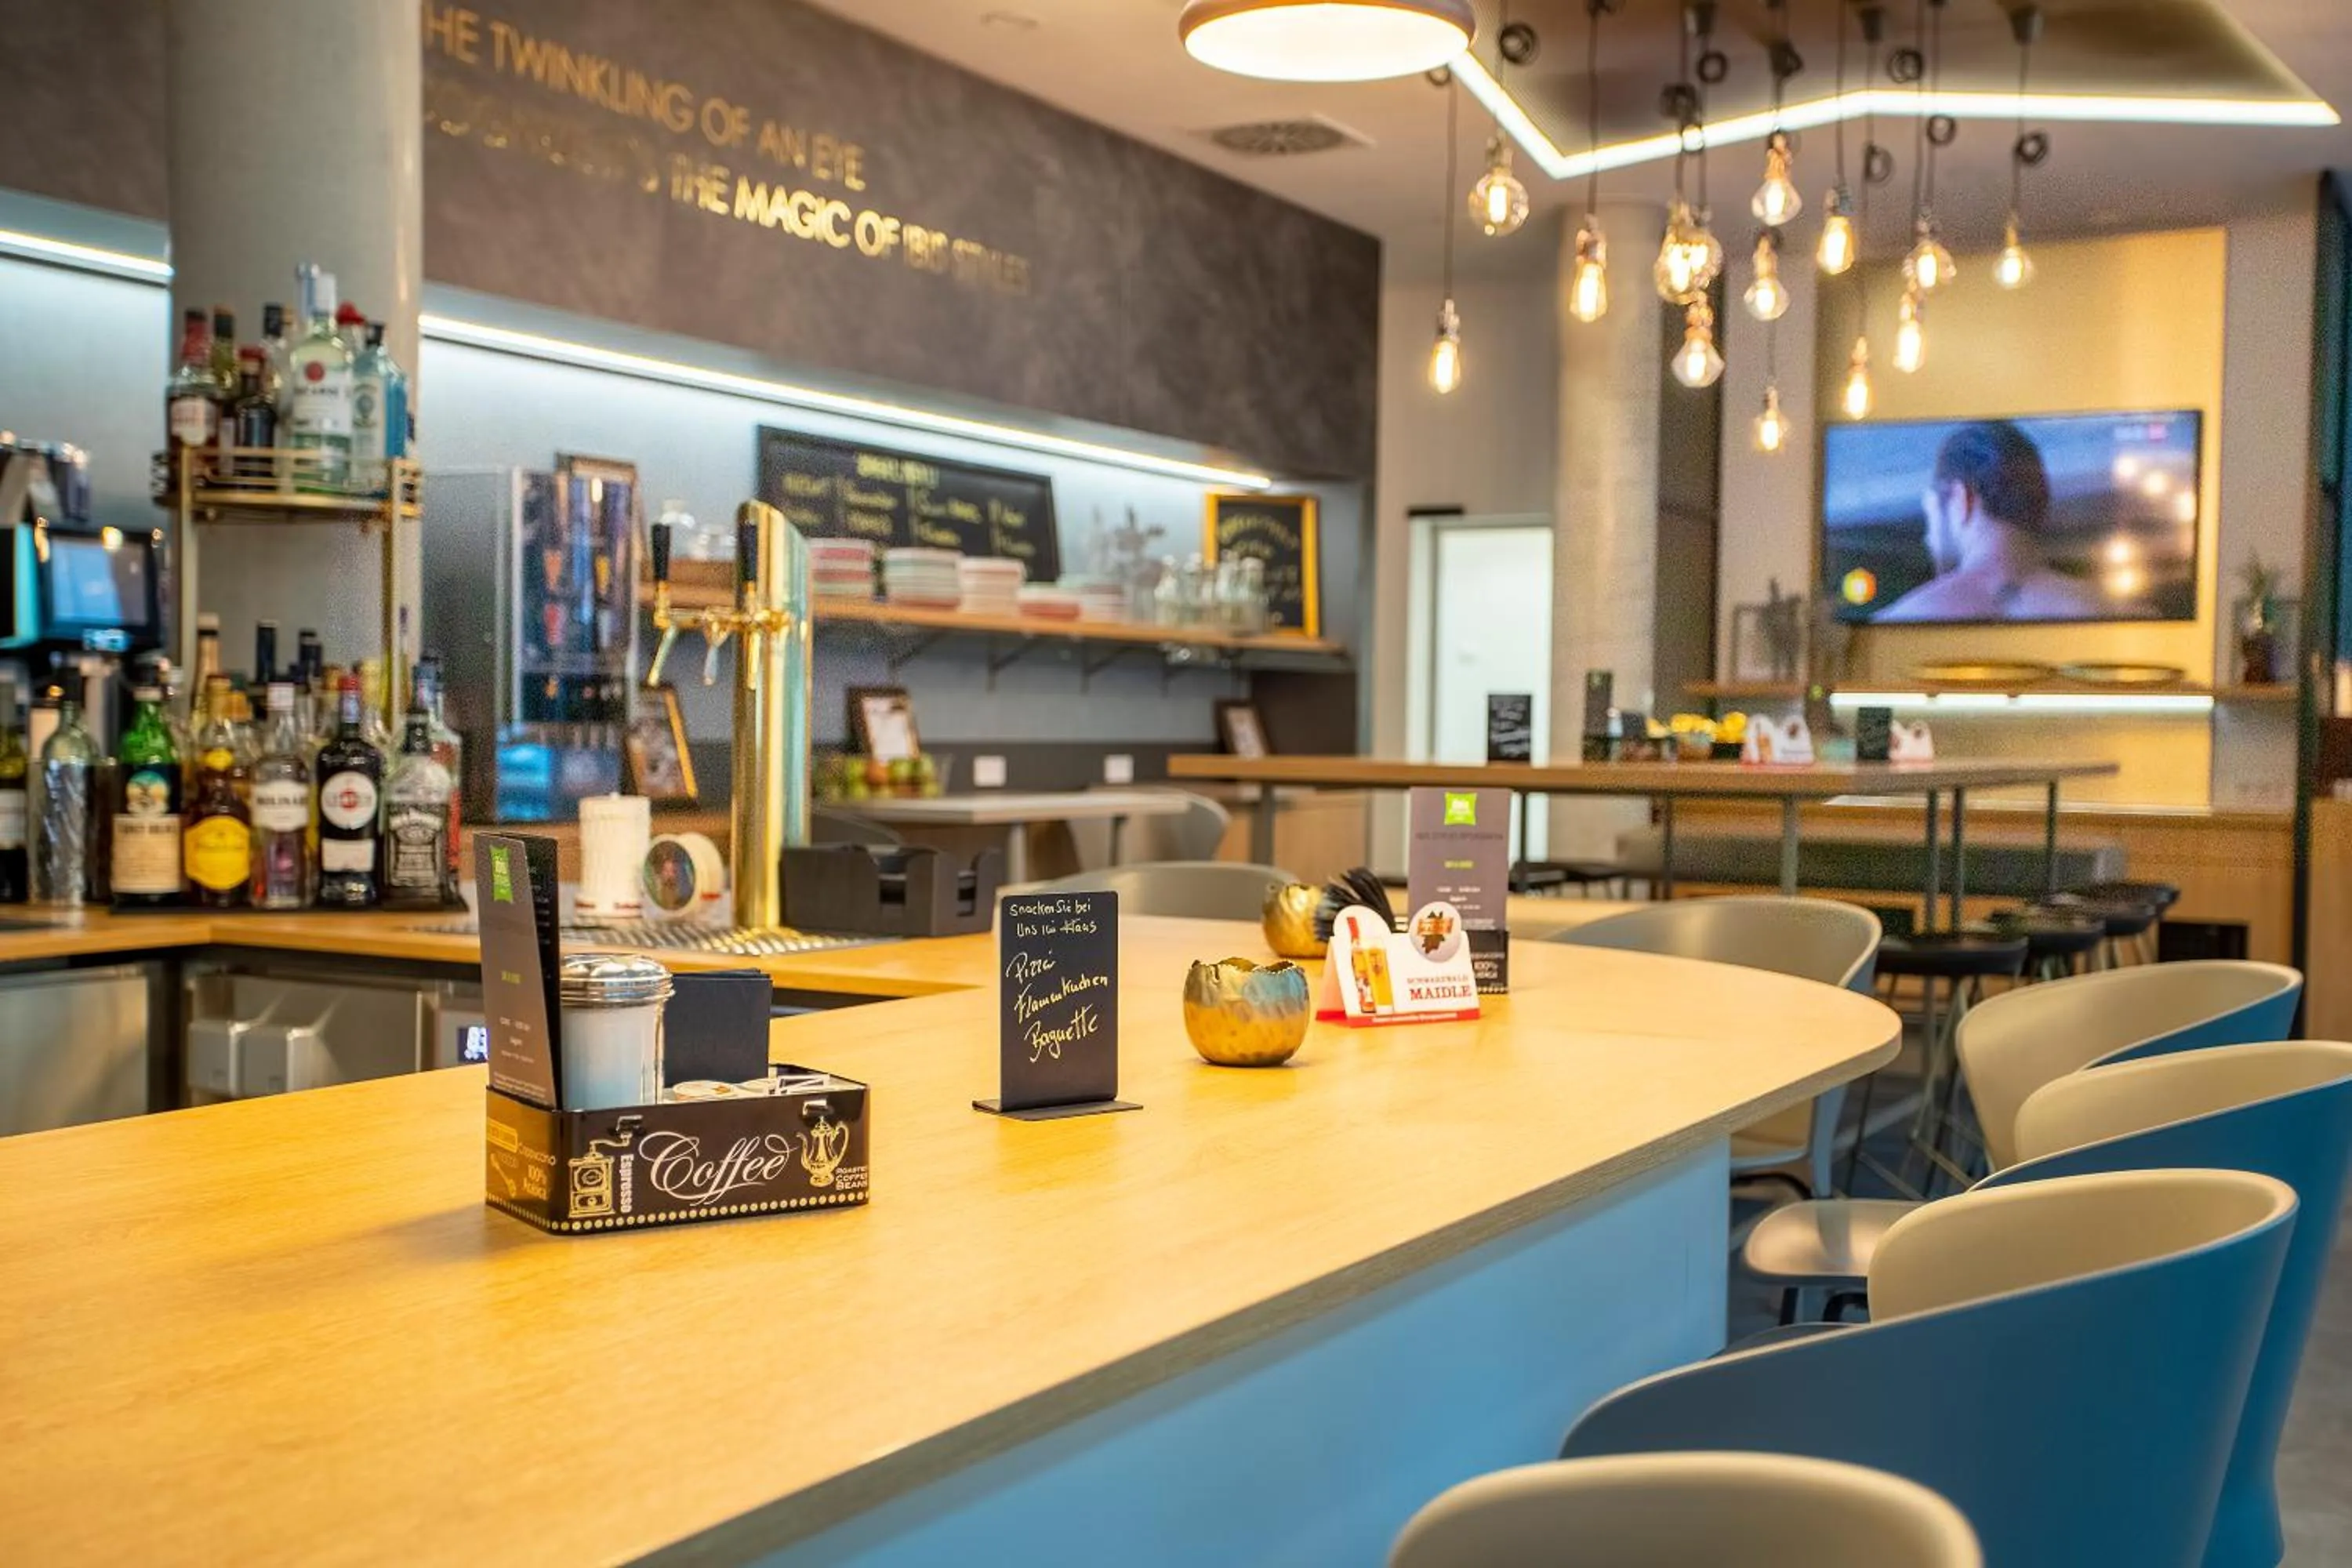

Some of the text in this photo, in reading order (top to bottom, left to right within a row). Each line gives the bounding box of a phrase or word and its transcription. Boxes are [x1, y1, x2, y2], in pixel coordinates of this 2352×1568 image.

[488, 20, 695, 134] TWINKLING
[700, 96, 750, 147] OF
[734, 175, 852, 249] MAGIC
[855, 209, 901, 259] OF
[1059, 918, 1097, 935] Haus
[1006, 951, 1057, 984] Pizza
[1409, 985, 1472, 1001] MAIDLE
[1024, 1004, 1098, 1063] Baguette
[619, 1153, 634, 1214] Espresso
[638, 1131, 800, 1207] Coffee
